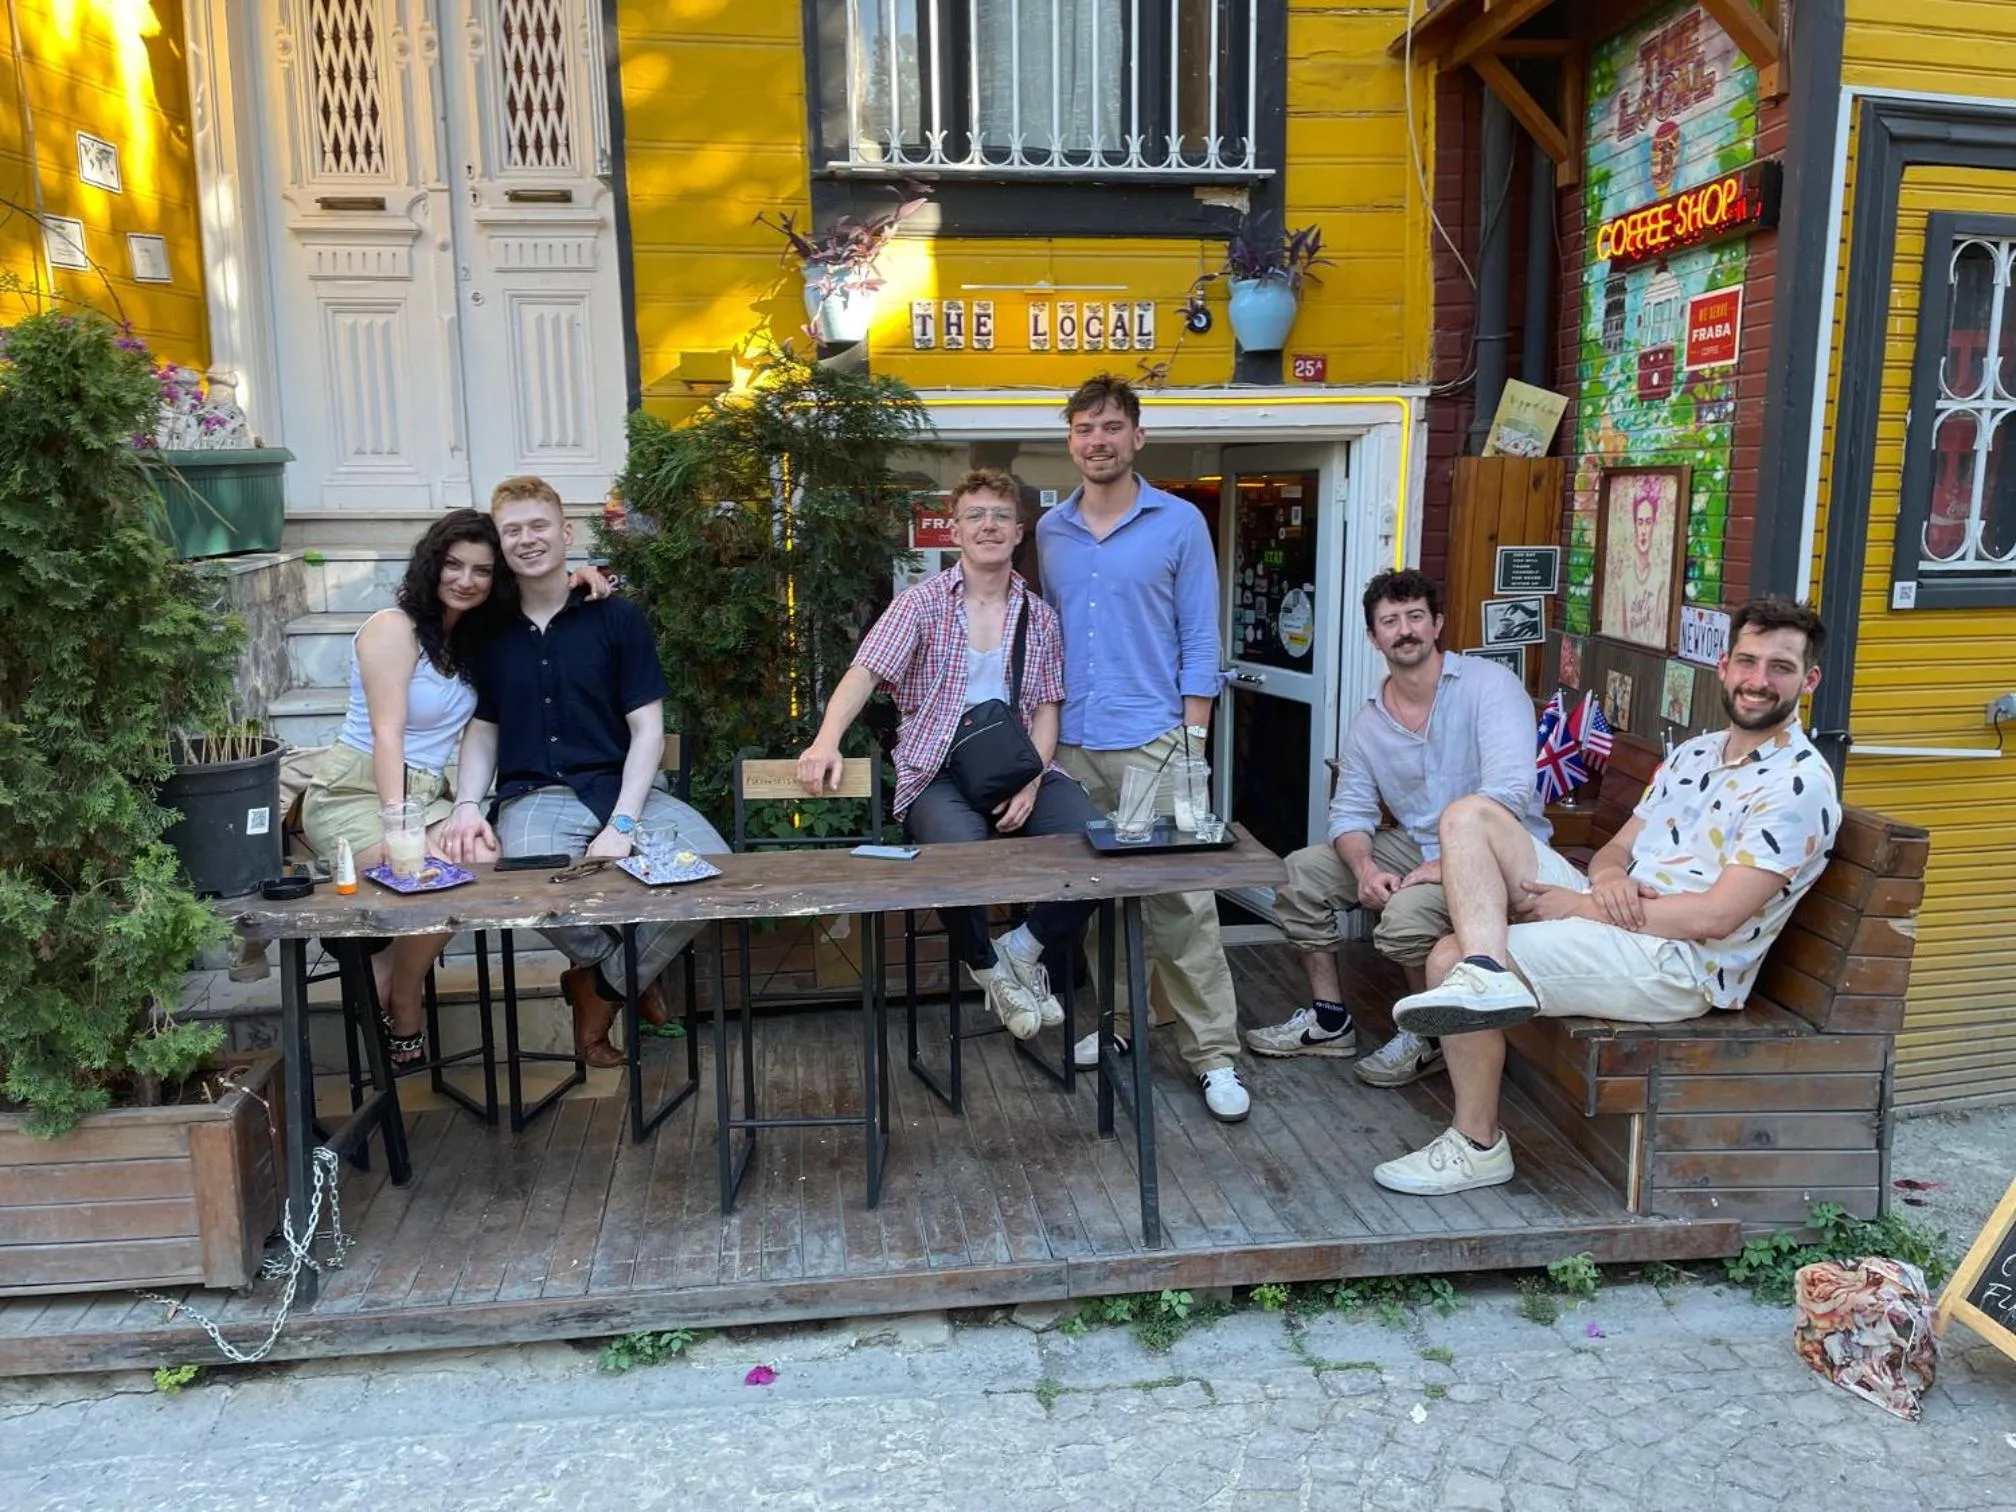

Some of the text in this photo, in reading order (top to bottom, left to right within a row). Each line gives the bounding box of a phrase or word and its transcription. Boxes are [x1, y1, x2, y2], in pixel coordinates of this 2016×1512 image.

[1597, 177, 1739, 261] COFFEE SHOP
[915, 312, 1152, 338] THE LOCAL
[1692, 322, 1733, 343] FRABA
[922, 518, 955, 529] FRA
